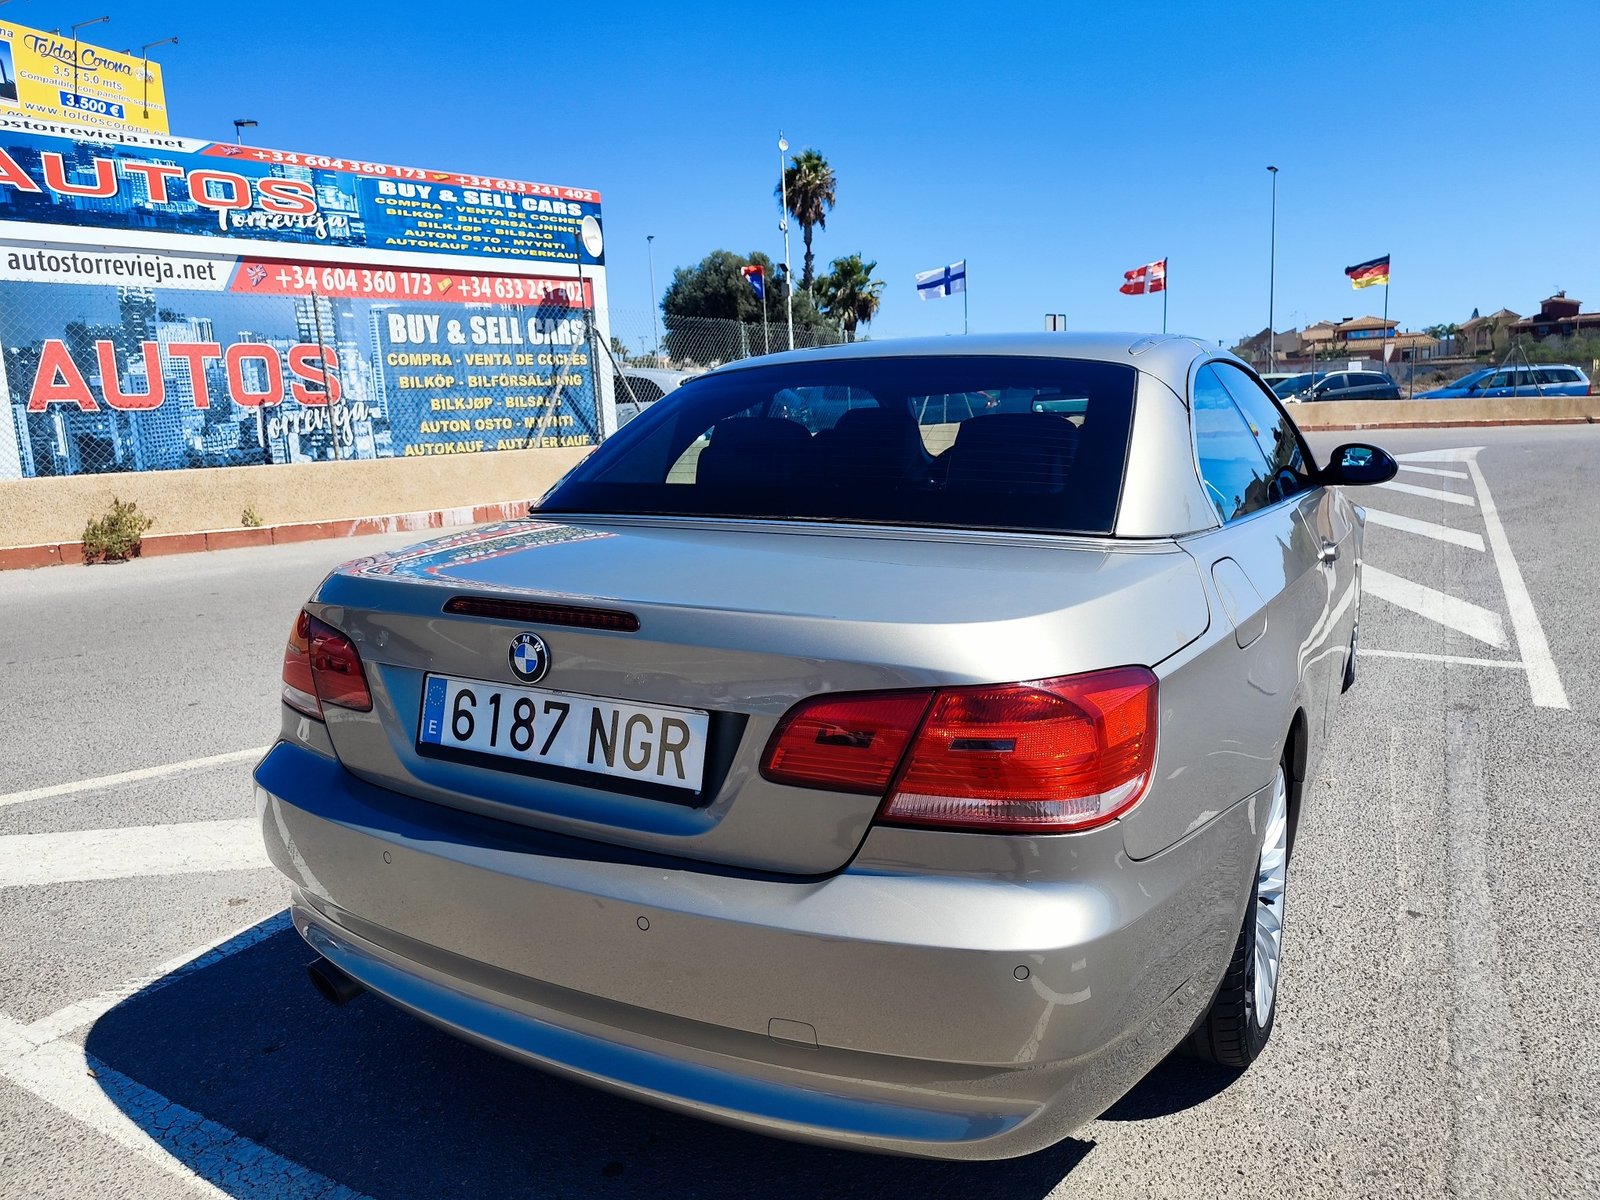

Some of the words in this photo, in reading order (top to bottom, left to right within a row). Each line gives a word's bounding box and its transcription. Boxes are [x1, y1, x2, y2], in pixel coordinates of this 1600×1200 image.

[24, 34, 78, 64] Toldos
[81, 49, 133, 76] Corona
[20, 70, 75, 89] Compatible
[77, 85, 94, 94] con
[97, 90, 131, 103] paneles
[133, 98, 164, 111] solares
[102, 79, 125, 91] mts.
[66, 94, 107, 114] 3.500
[109, 105, 120, 117] €
[252, 151, 299, 164] +34
[304, 156, 344, 169] 604
[349, 161, 387, 175] 360
[392, 167, 426, 180] 173
[378, 181, 433, 200] BUY
[438, 188, 458, 203] &
[463, 190, 517, 209] SELL
[522, 197, 583, 217] CARS
[455, 175, 491, 188] +34
[496, 180, 527, 193] 633
[531, 185, 559, 197] 241
[564, 188, 593, 201] 402
[374, 197, 442, 211] COMPRA
[455, 205, 503, 217] VENTA
[508, 211, 527, 220] DE
[385, 207, 444, 221] BILKÖP
[209, 207, 348, 240] Torrevieja
[417, 220, 482, 234] BILKJØP
[496, 228, 553, 240] BILSALG
[385, 237, 470, 251] AUTOKAUF
[404, 229, 458, 241] AUTON
[462, 234, 501, 244] OSTO
[513, 239, 566, 250] MYYNTI
[7, 250, 217, 283] autostorrevieja.net
[275, 265, 317, 290] +34
[322, 268, 358, 292] 604
[363, 268, 397, 293] 360
[400, 272, 432, 295] 173
[457, 276, 491, 298] +34
[495, 277, 524, 300] 633
[527, 279, 554, 300] 241
[558, 281, 583, 302] 402
[388, 313, 440, 344] BUY
[447, 319, 466, 345] &
[470, 316, 524, 345] SELL
[527, 317, 586, 346] CARS
[387, 353, 453, 367] COMPRA
[464, 354, 513, 366] VENTA
[516, 354, 535, 366] DE
[27, 338, 342, 412] AUTOS
[399, 374, 454, 390] BILKÖP
[431, 396, 493, 411] BILKJØP
[246, 401, 371, 448] Torreveja
[419, 420, 470, 433] AUTON
[474, 417, 513, 431] OSTO
[404, 442, 484, 458] AUTOKAUF
[512, 635, 543, 653] BMW
[428, 719, 438, 735] E
[451, 688, 570, 756] 6187
[587, 706, 691, 780] NGR
